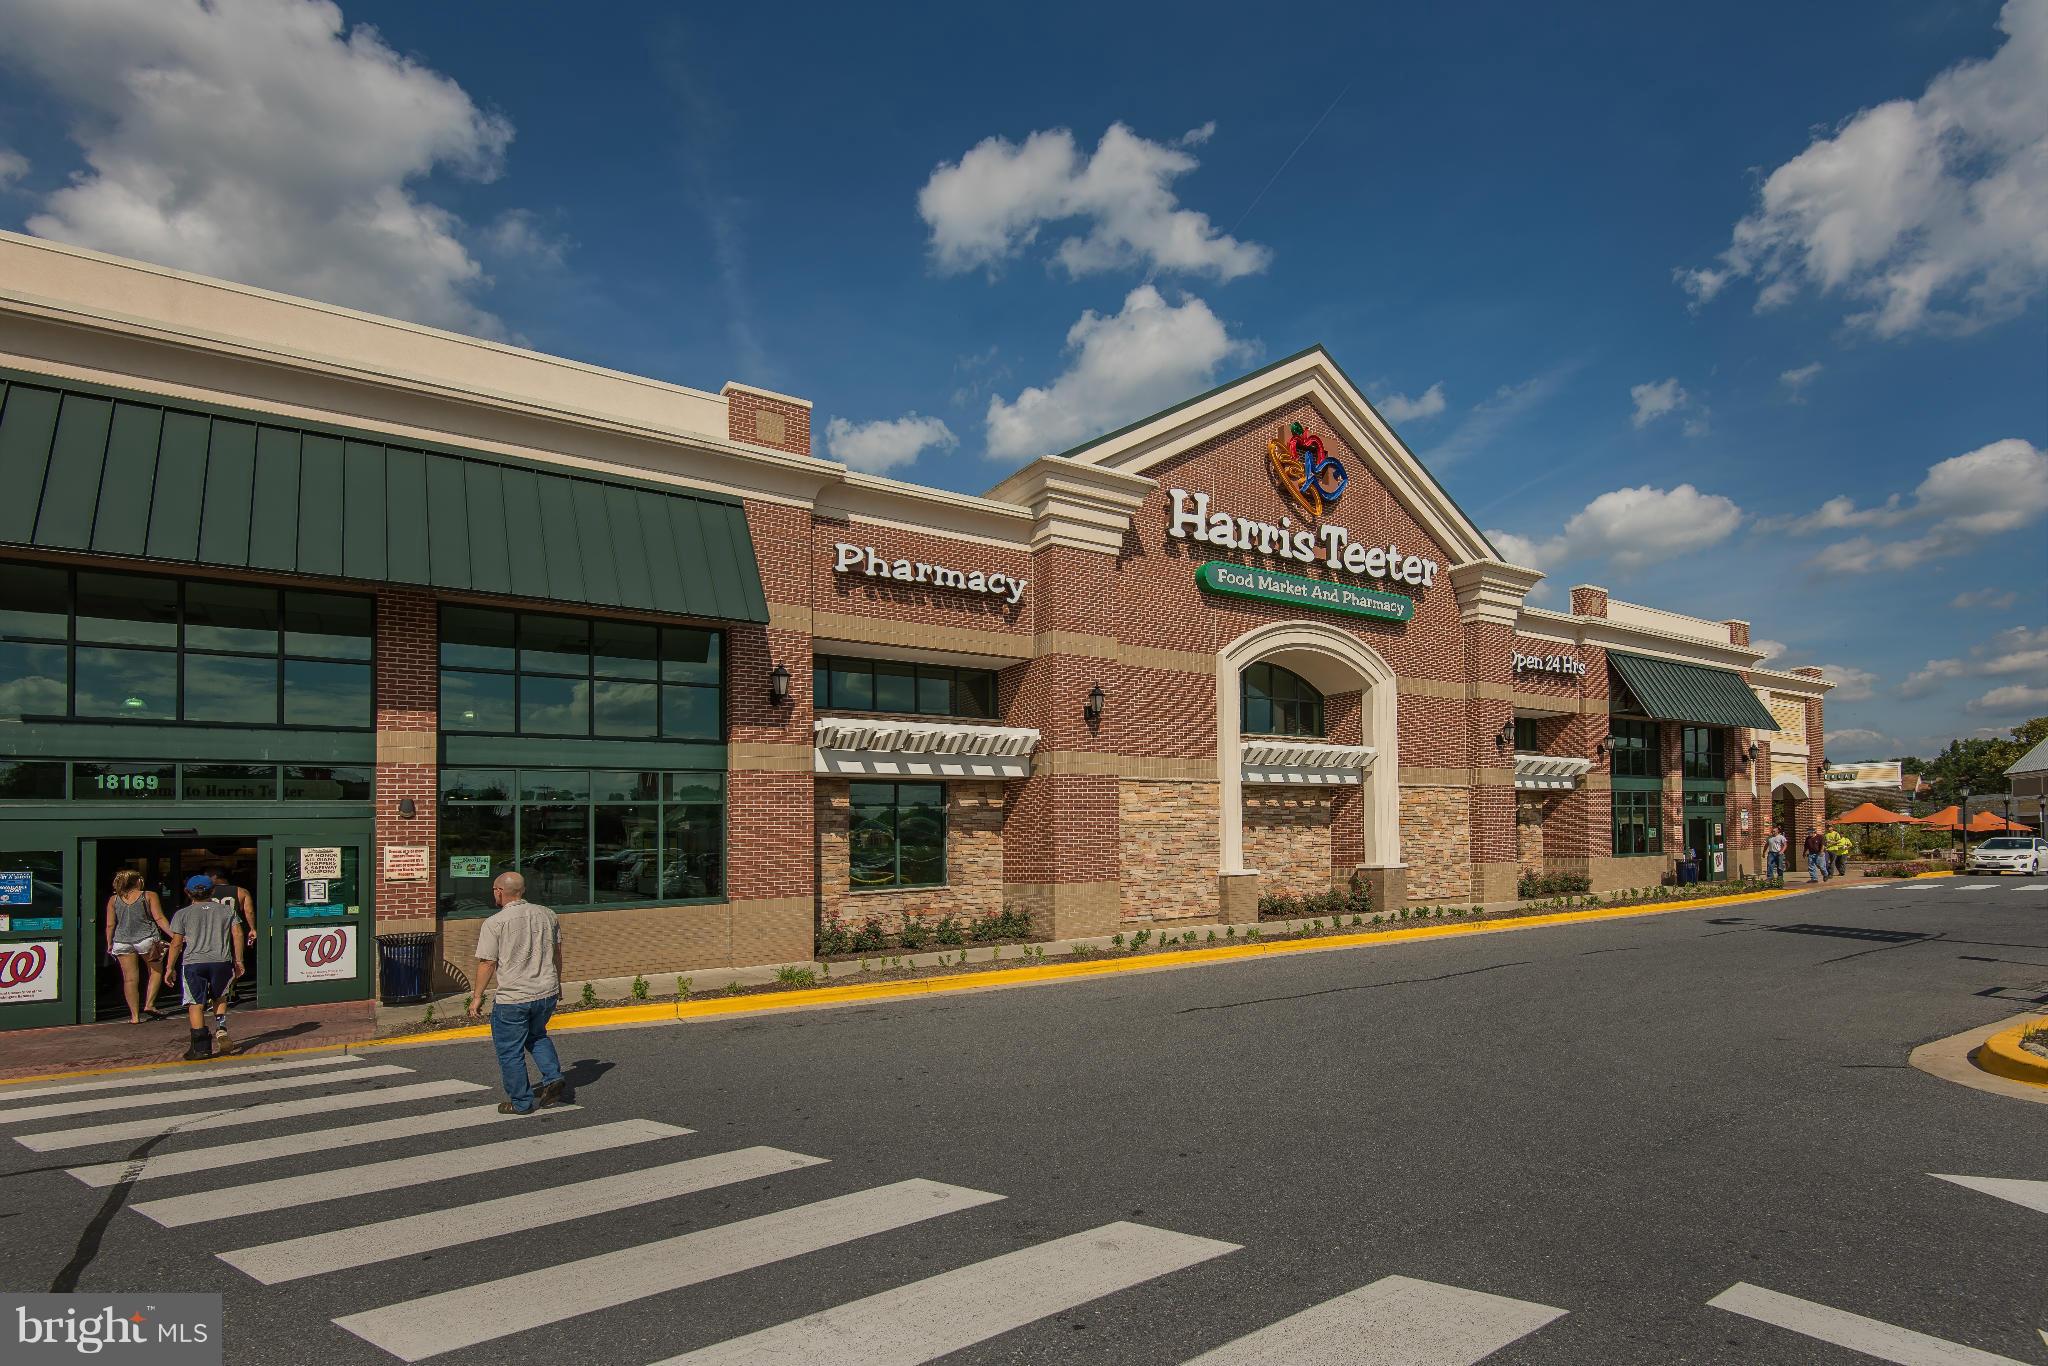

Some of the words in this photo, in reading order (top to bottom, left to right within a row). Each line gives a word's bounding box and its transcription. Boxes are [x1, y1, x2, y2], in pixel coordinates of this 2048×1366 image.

[1168, 488, 1316, 563] Harris
[1320, 524, 1438, 587] Teeter
[833, 542, 1028, 604] Pharmacy
[1217, 568, 1254, 589] Food
[1258, 576, 1308, 597] Market
[1311, 586, 1338, 603] And
[1342, 590, 1405, 617] Pharmacy
[1545, 654, 1560, 673] 24
[1562, 655, 1586, 675] Hrs
[94, 774, 159, 790] 18169
[206, 784, 255, 798] Harris
[258, 785, 305, 798] Teter
